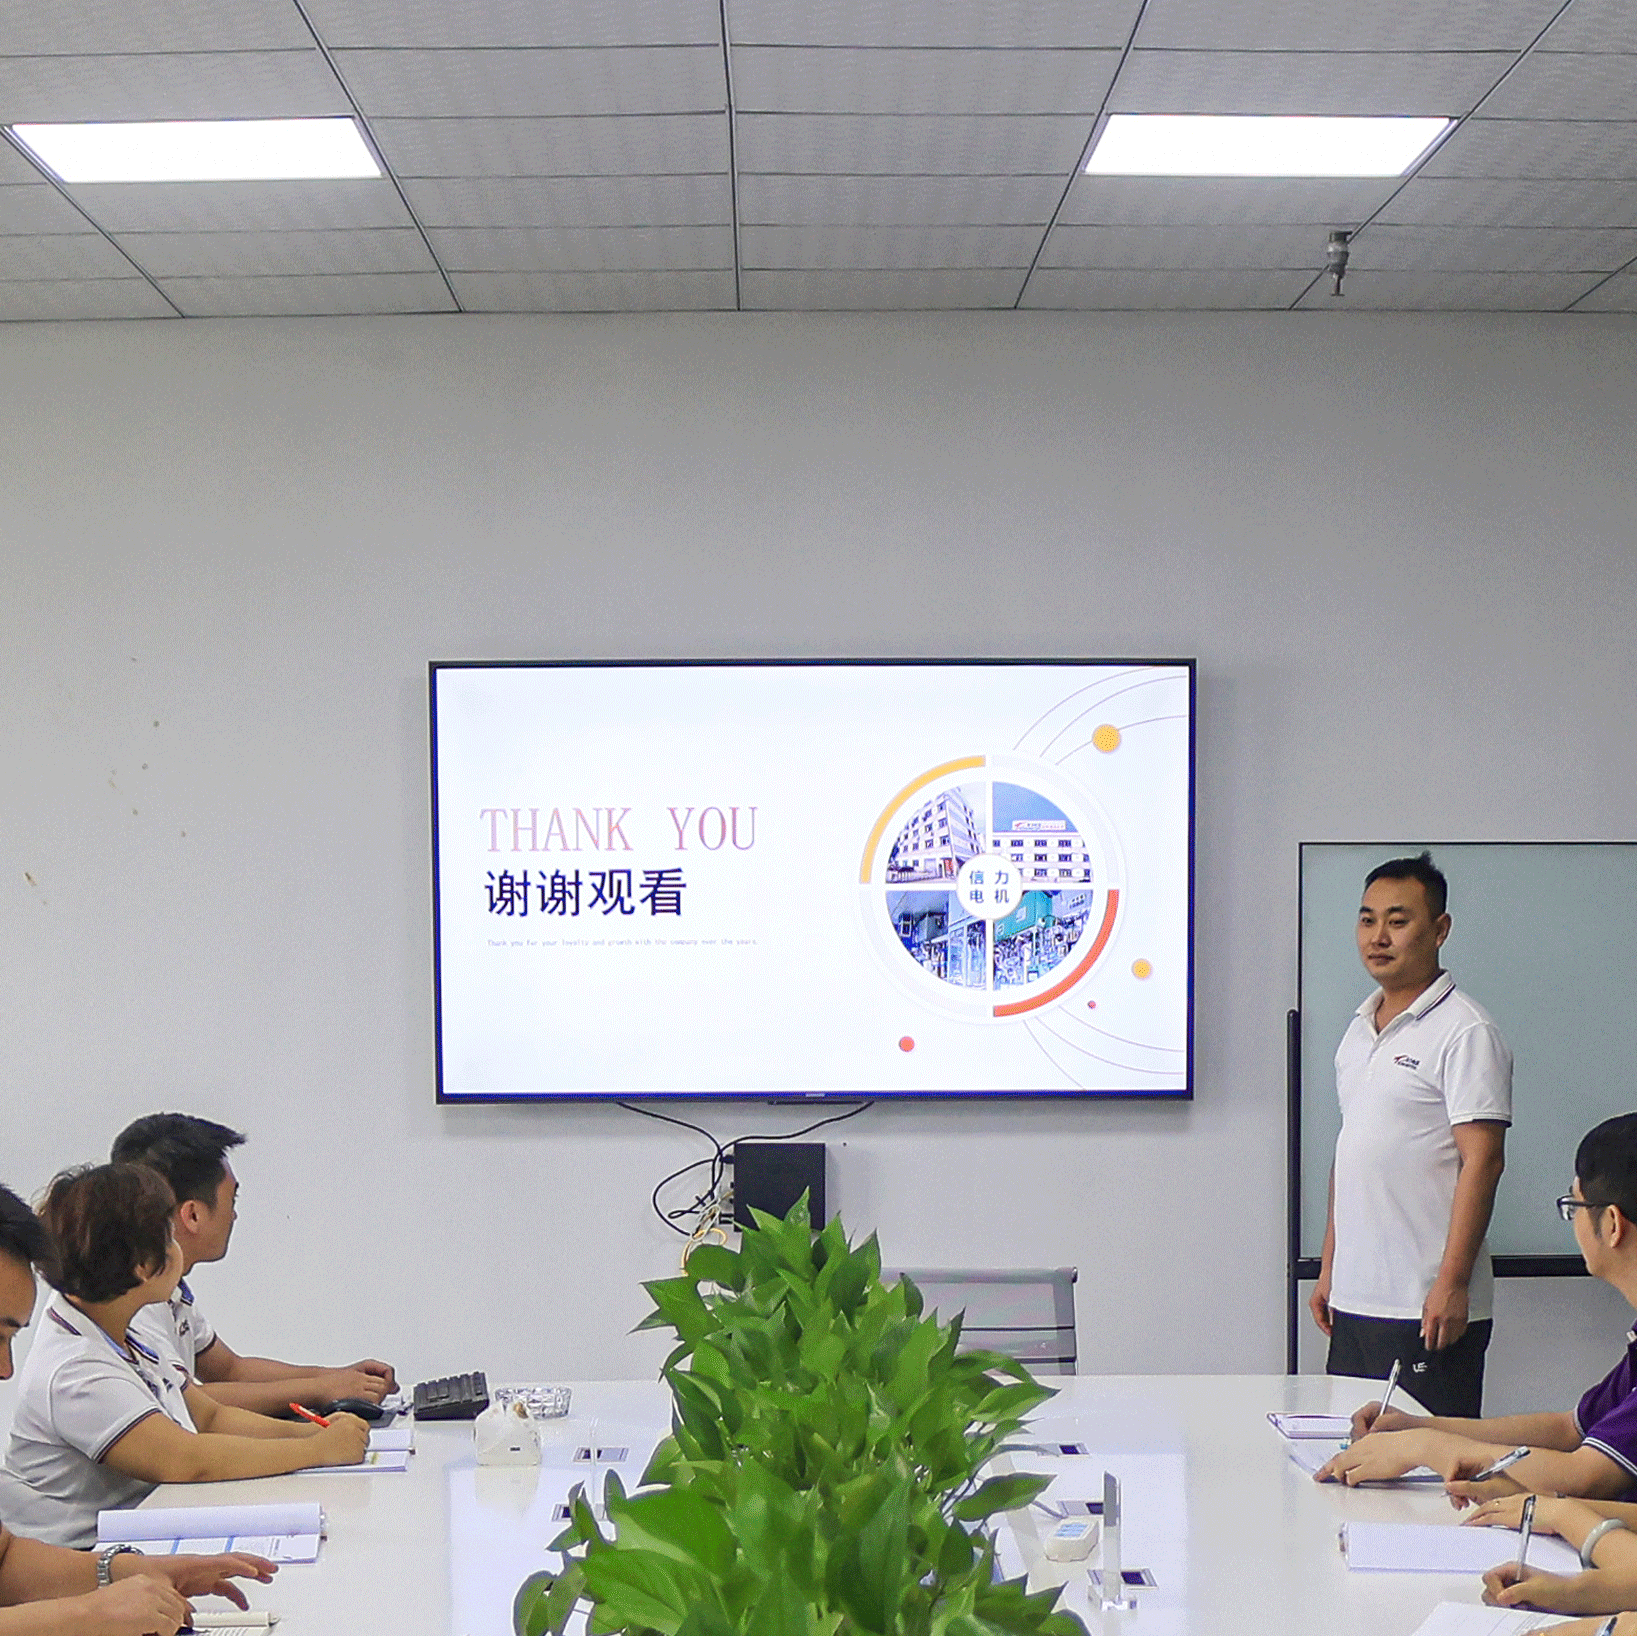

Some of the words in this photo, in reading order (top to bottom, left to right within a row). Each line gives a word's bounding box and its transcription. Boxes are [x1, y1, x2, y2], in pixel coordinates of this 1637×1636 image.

[479, 807, 634, 852] THANK
[666, 806, 759, 851] YOU
[484, 867, 687, 917] 谢谢观看
[969, 870, 1009, 885] 信力
[969, 889, 1010, 904] 电机
